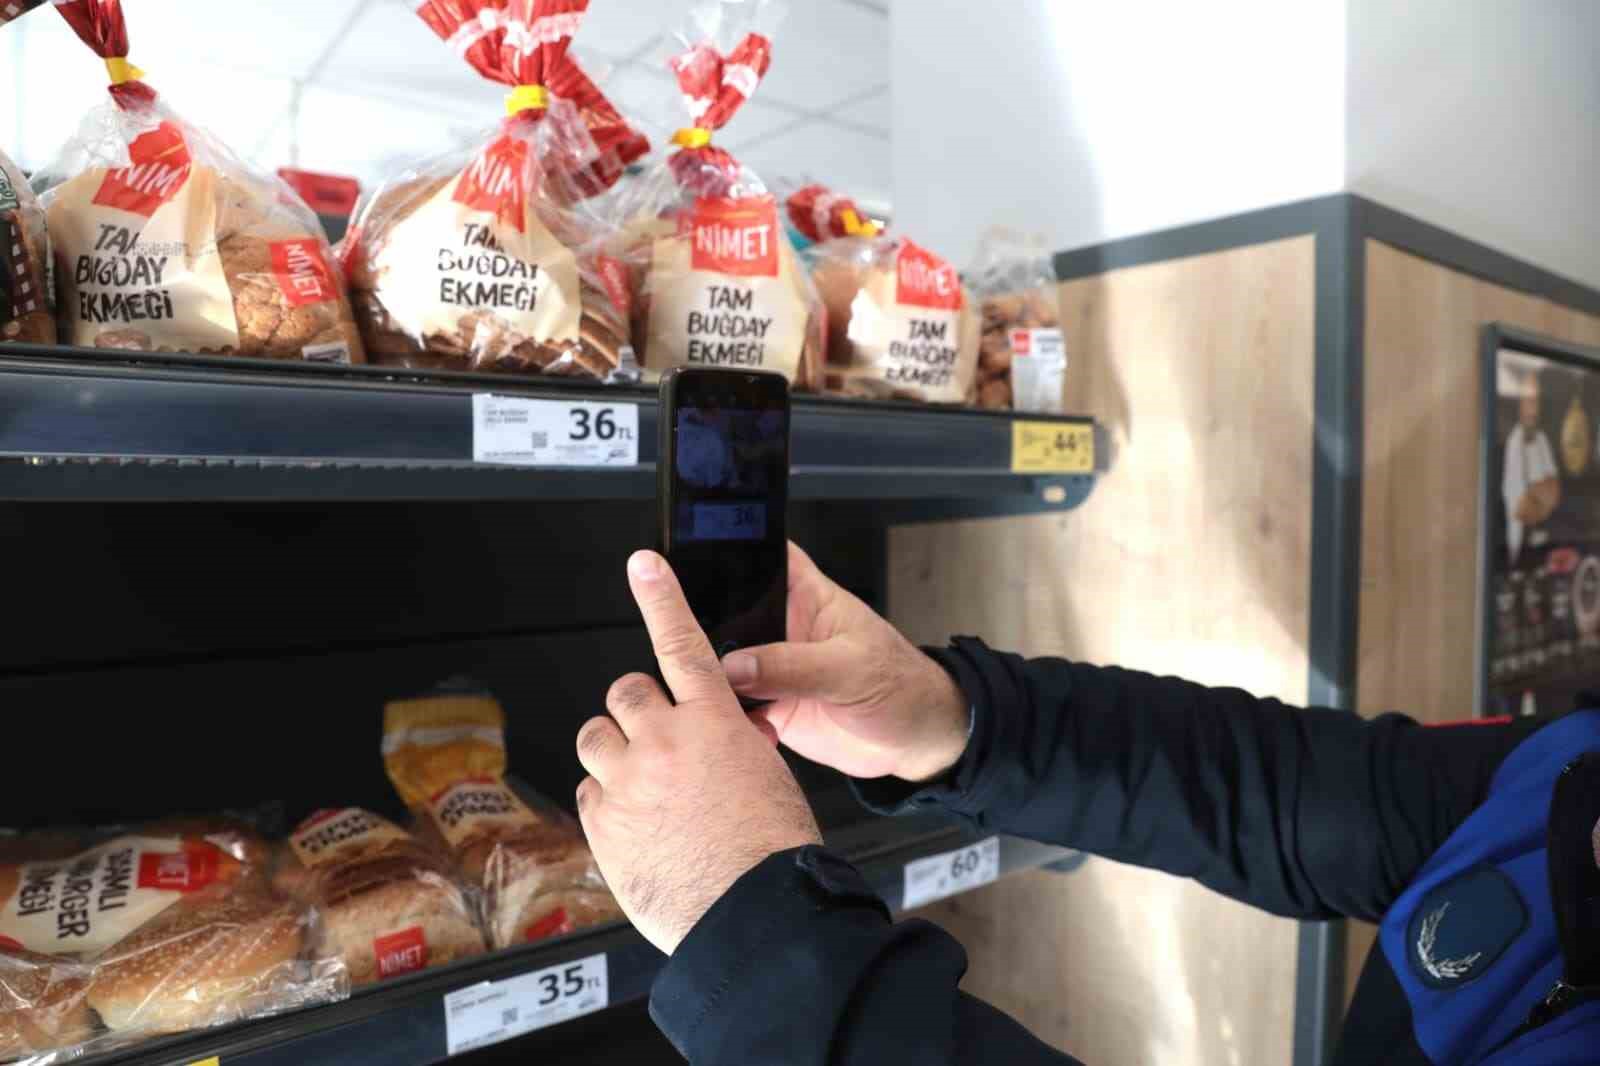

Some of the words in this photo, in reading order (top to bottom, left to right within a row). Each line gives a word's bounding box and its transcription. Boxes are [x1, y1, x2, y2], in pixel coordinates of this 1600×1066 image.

[707, 285, 753, 311] TAM
[910, 319, 947, 340] TAM
[569, 408, 616, 441] 36
[618, 427, 633, 440] TL
[950, 850, 980, 879] 60
[538, 964, 585, 1006] 35
